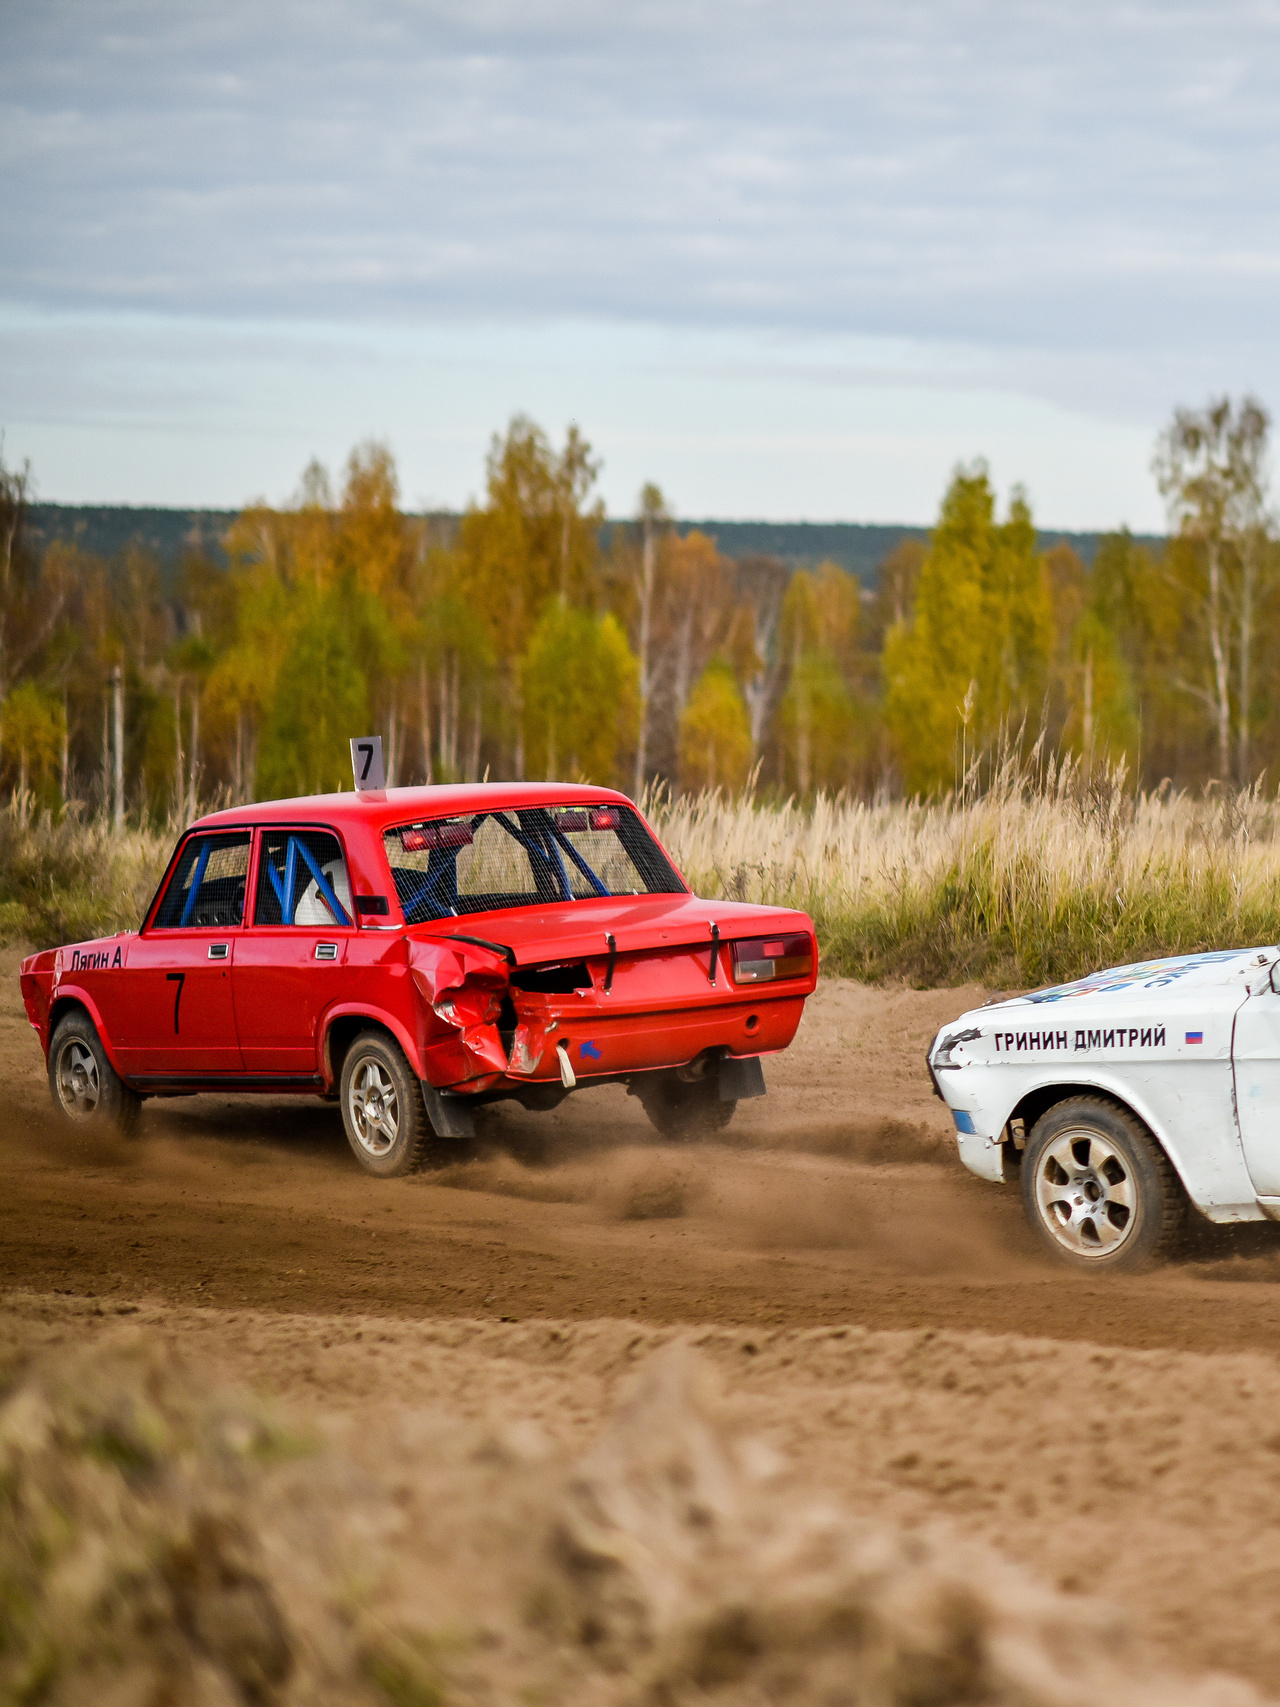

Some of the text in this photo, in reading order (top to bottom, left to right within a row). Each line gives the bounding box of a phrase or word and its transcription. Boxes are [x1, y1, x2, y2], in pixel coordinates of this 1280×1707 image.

[357, 743, 374, 781] 7
[71, 946, 122, 972] Лягин А
[166, 973, 185, 1035] 7
[994, 1023, 1166, 1052] ГРИНИН ДМИТРИЙ
